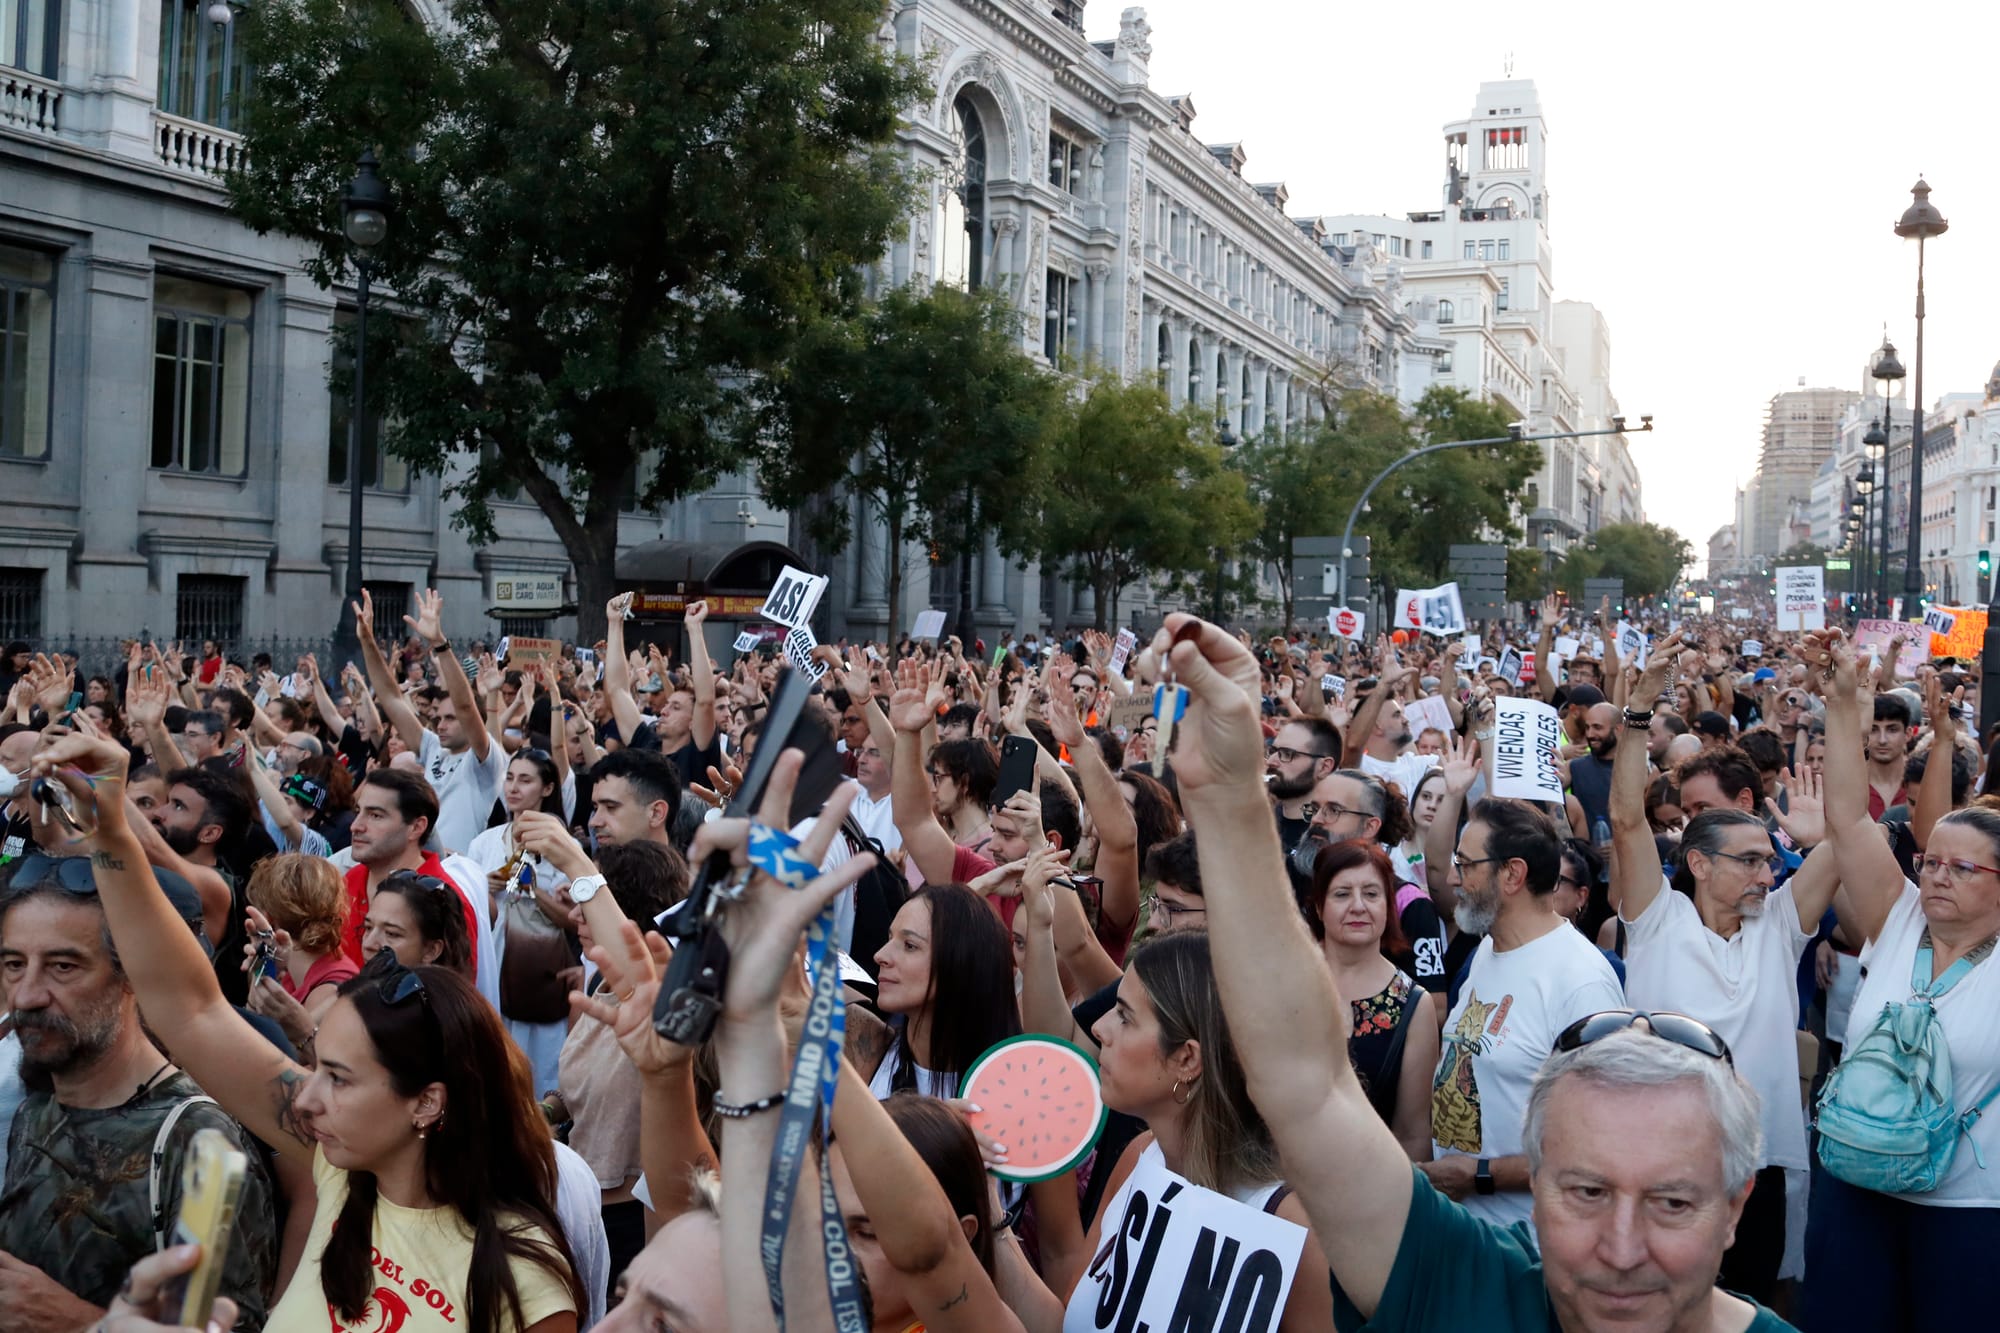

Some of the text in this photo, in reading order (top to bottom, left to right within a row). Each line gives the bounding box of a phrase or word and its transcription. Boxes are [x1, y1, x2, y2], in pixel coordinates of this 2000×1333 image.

[516, 582, 554, 590] SIM AGUA
[516, 591, 533, 599] CARD
[1861, 621, 1922, 637] NUESTRAS
[790, 1042, 824, 1108] MAD
[807, 962, 838, 1040] COOL
[824, 1220, 852, 1297] COOL
[409, 1279, 456, 1323] SOL
